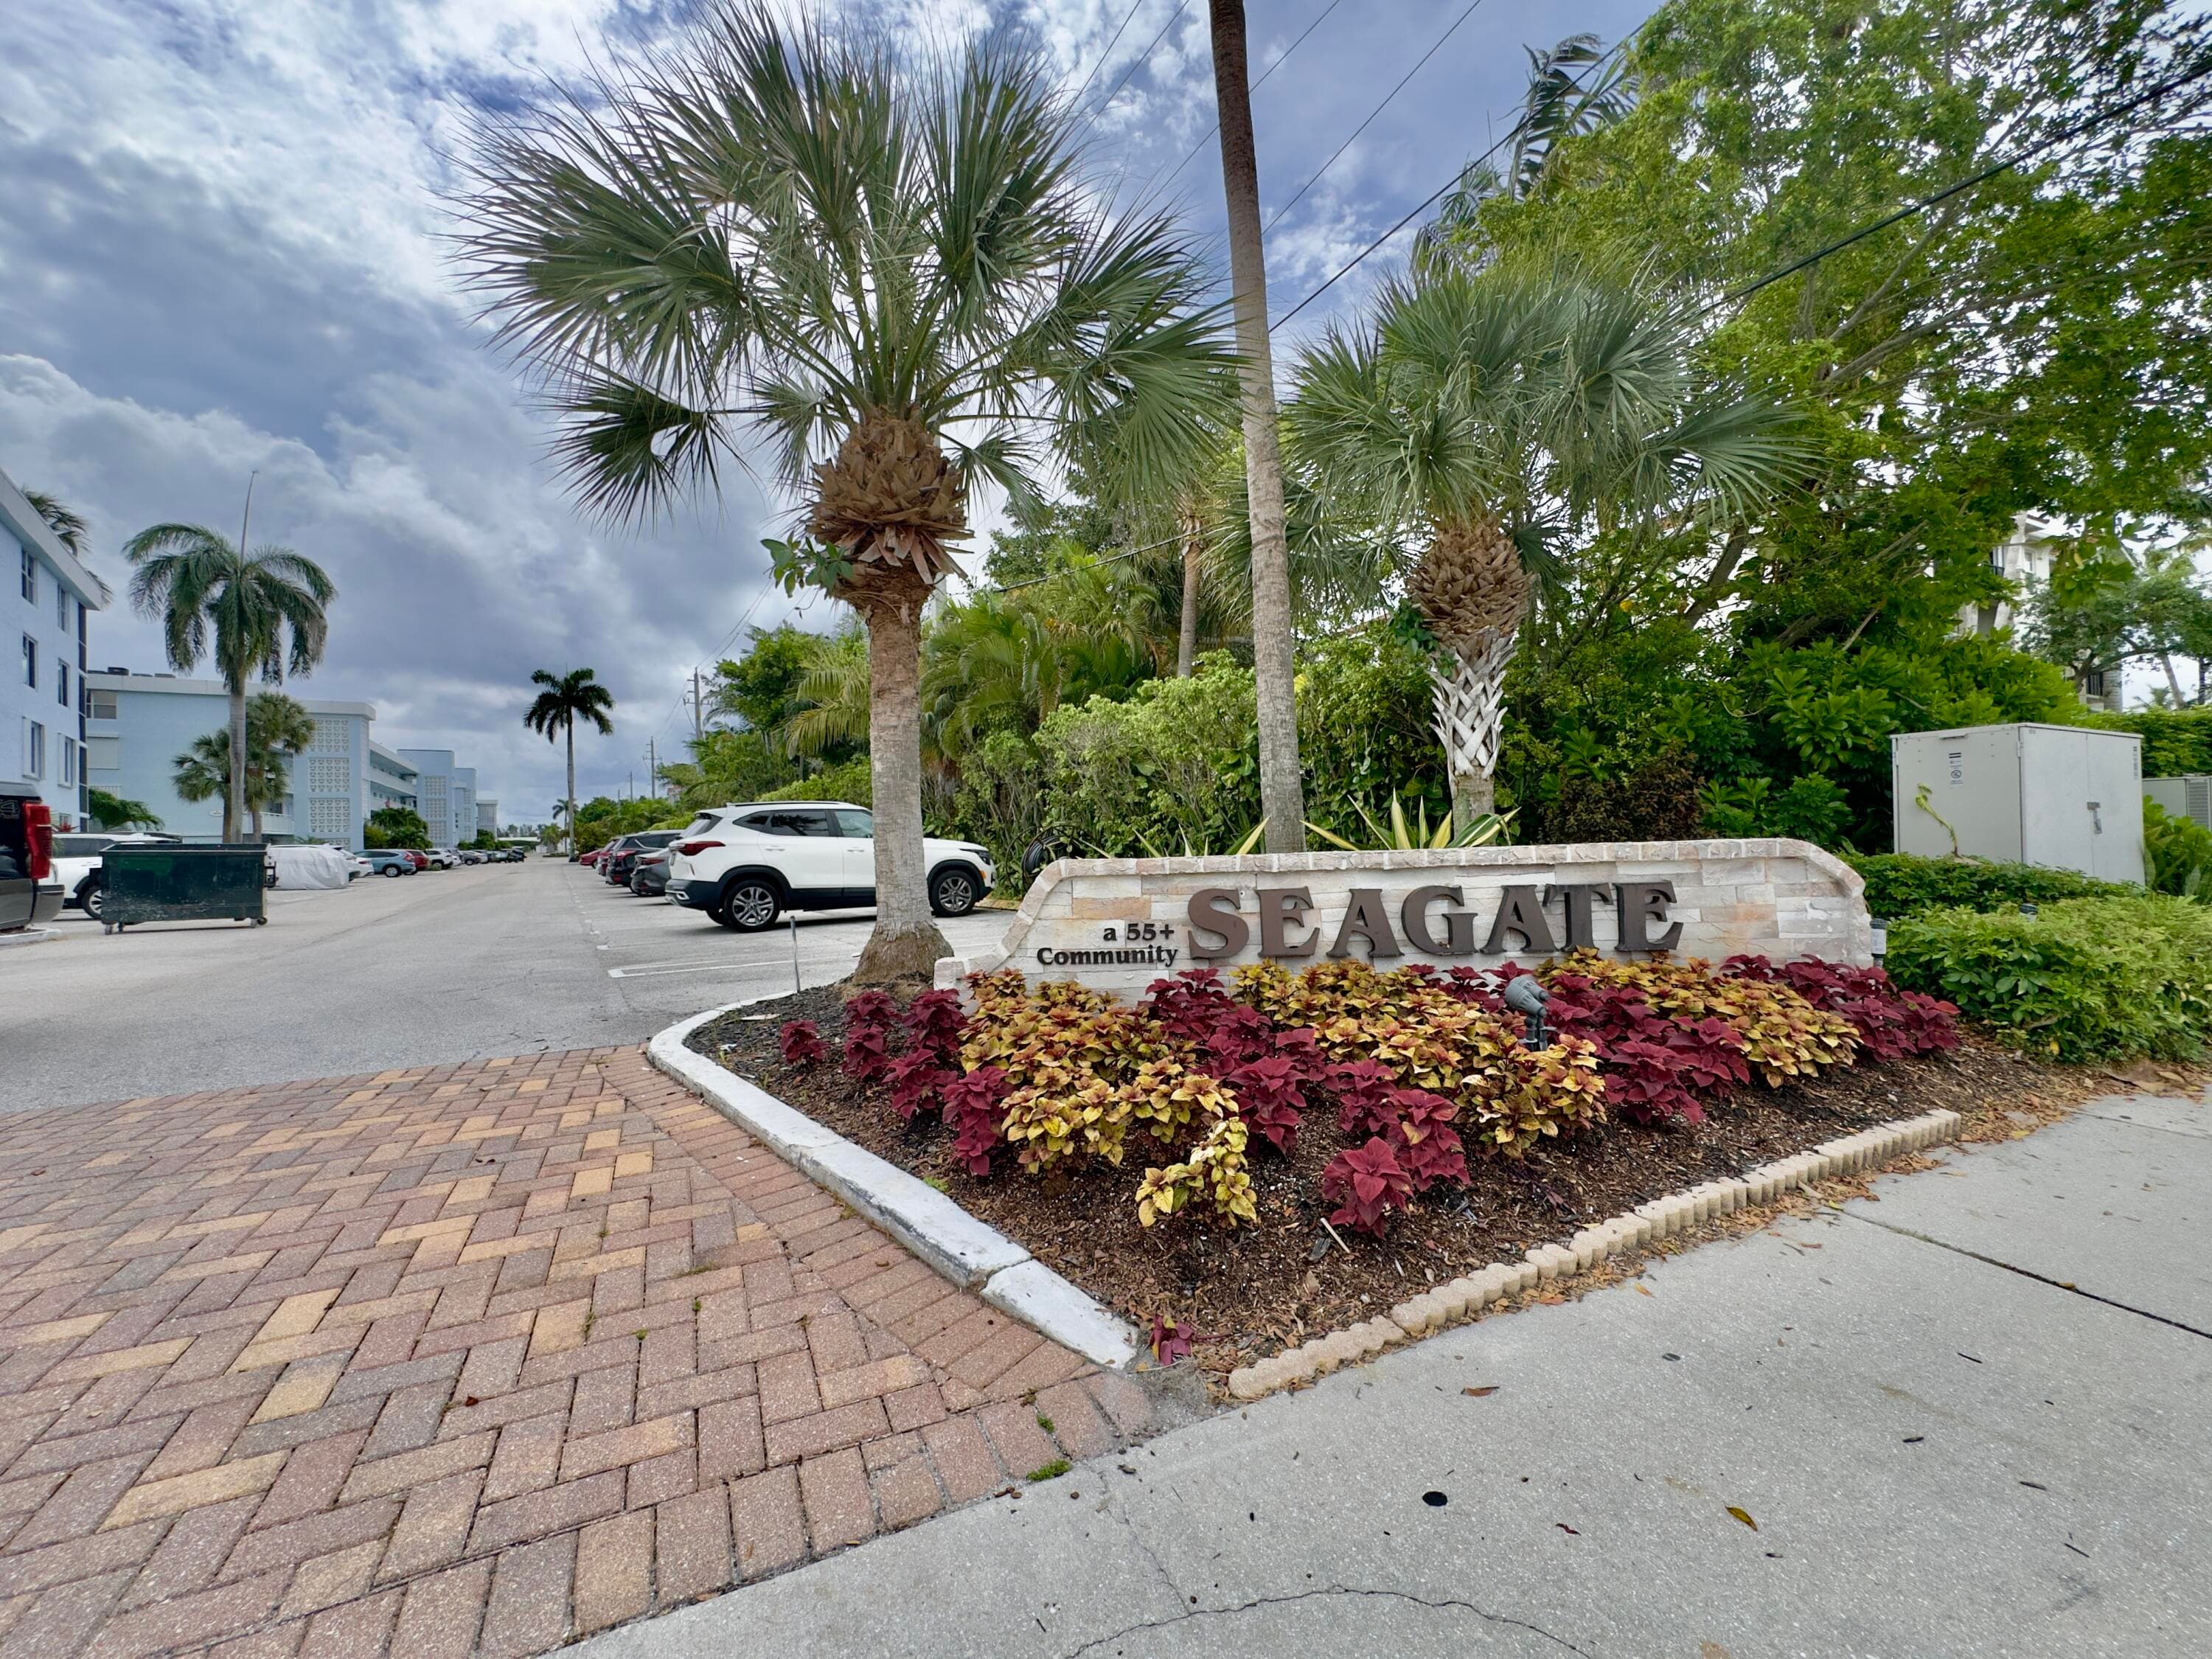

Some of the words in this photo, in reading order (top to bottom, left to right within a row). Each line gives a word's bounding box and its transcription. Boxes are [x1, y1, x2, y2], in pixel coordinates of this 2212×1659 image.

[1188, 881, 1683, 959] SEAGATE
[1103, 927, 1117, 941] a
[1127, 923, 1175, 942] 55+
[1037, 945, 1178, 967] Community
